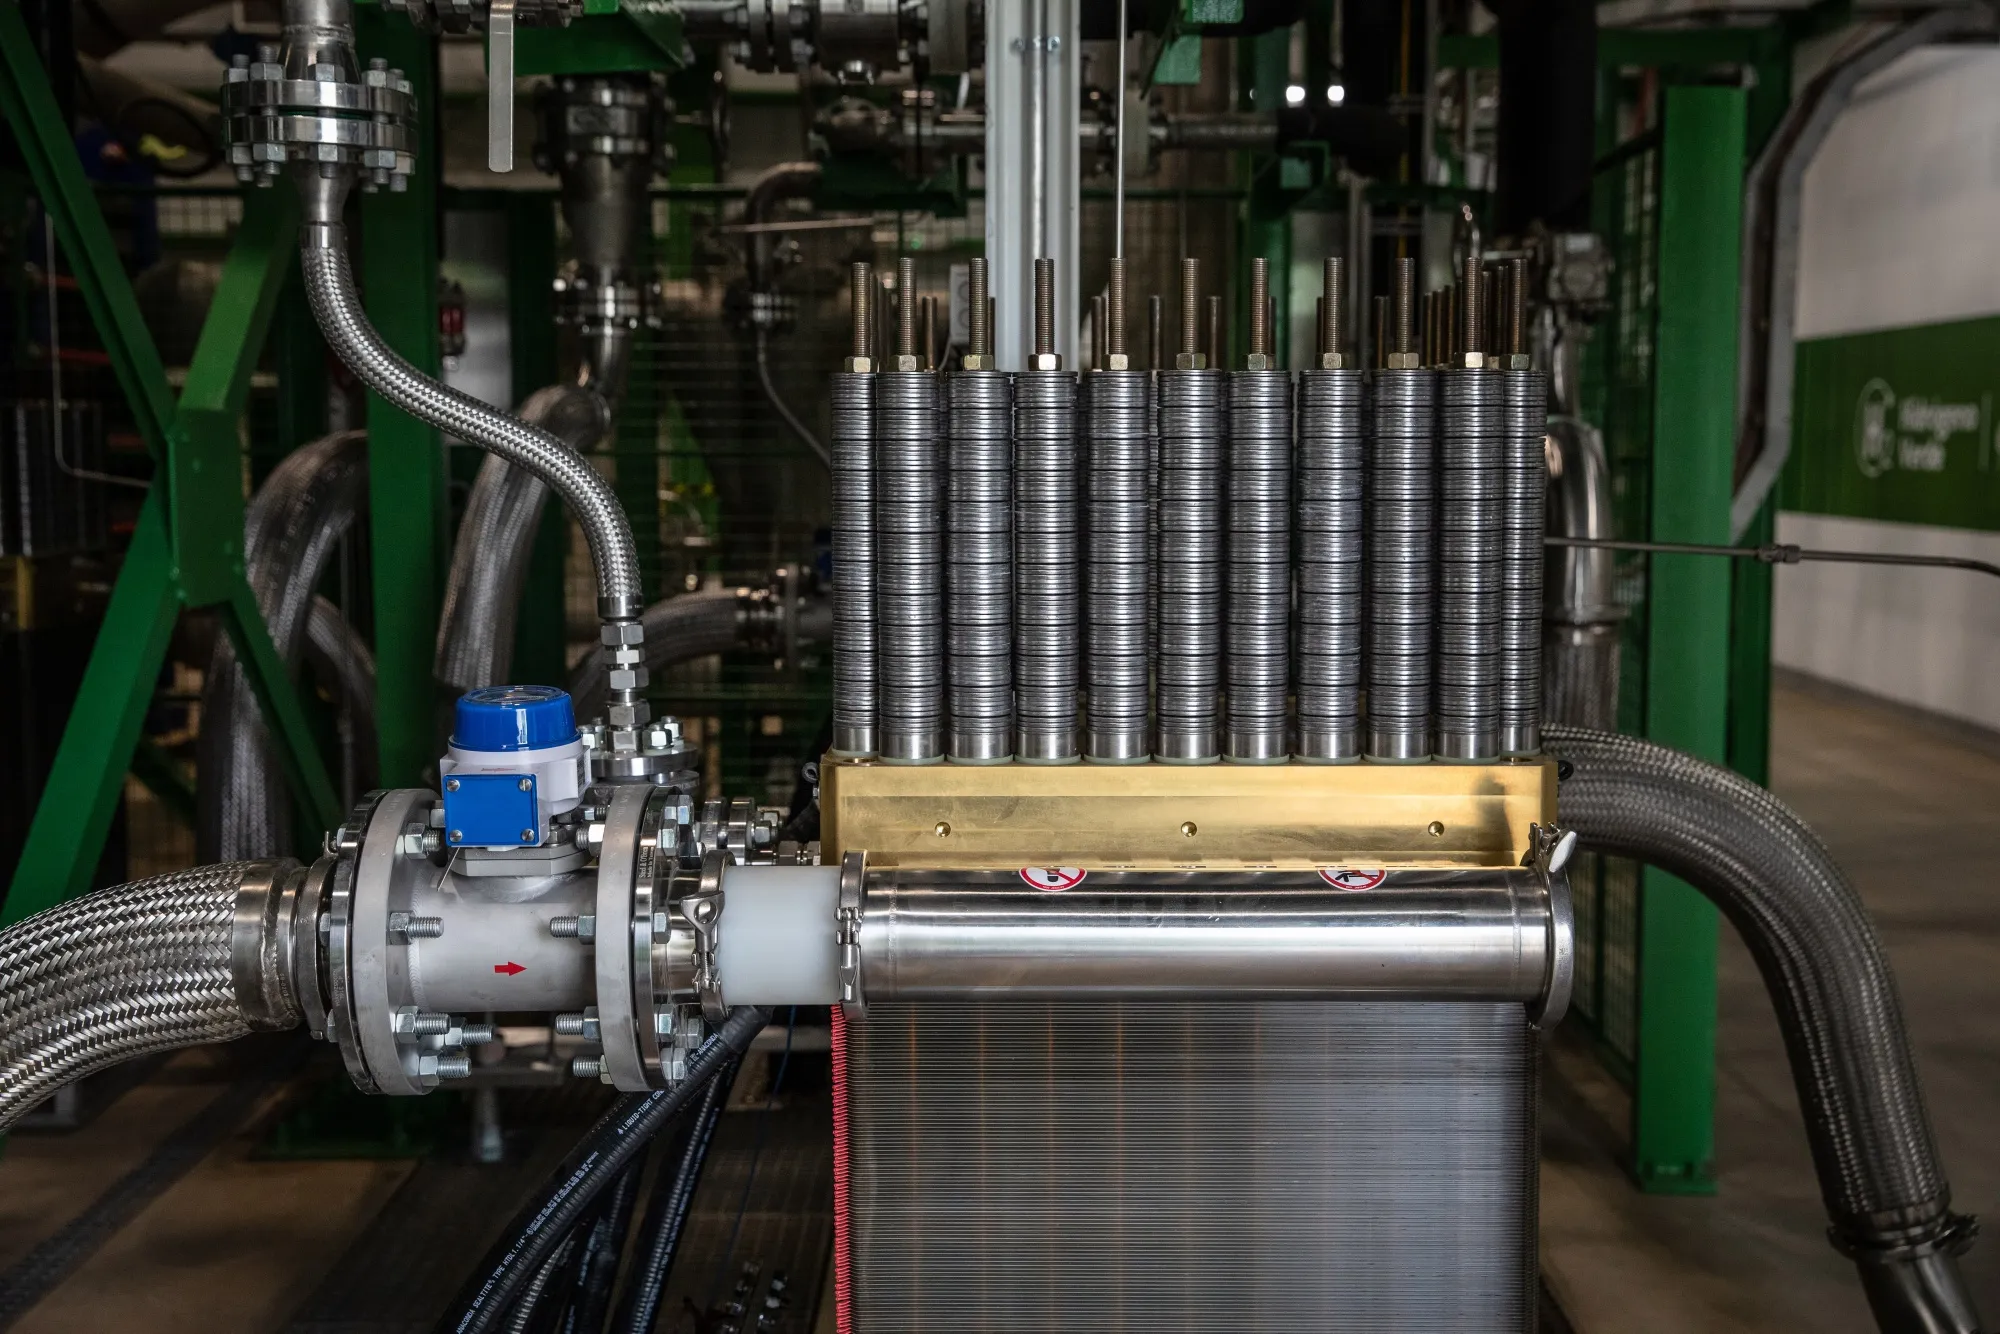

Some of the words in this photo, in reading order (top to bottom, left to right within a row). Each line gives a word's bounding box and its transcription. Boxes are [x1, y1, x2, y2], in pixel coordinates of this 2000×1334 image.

[622, 1099, 653, 1130] LIQUID-TIGHT
[456, 1309, 476, 1334] ANACONDA
[492, 1265, 506, 1279] TYPE
